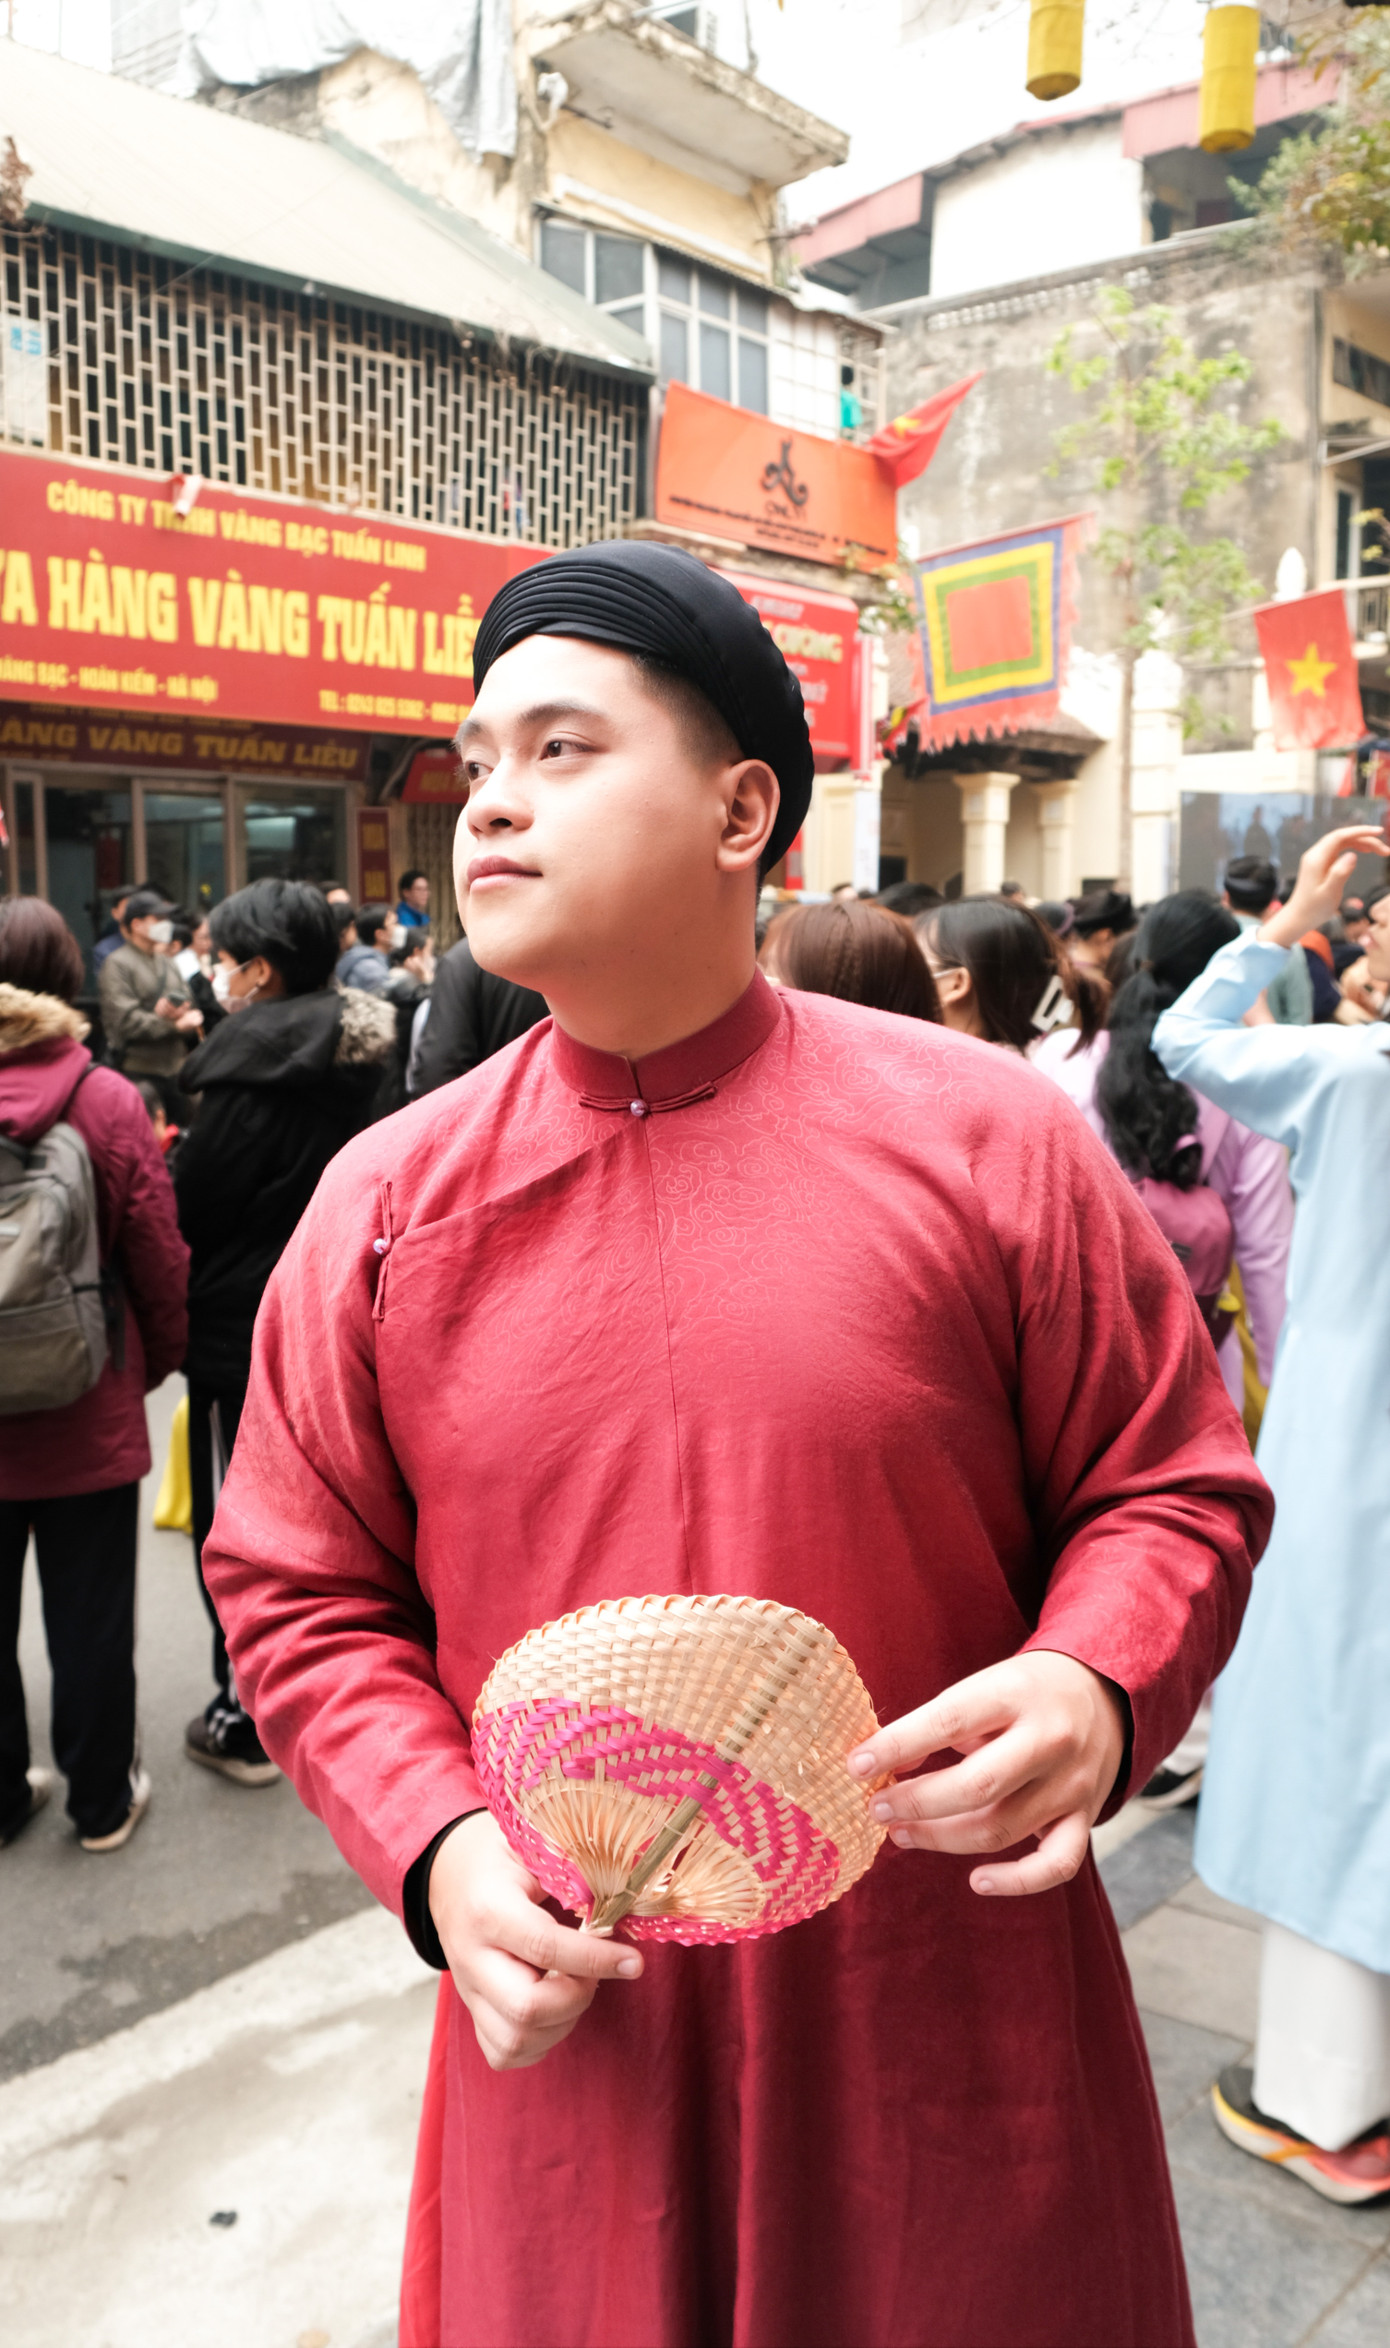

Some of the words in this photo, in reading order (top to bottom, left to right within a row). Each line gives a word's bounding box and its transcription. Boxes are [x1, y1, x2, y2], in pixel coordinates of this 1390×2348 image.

[47, 479, 114, 522] CÔNG
[118, 493, 147, 527] TY
[219, 508, 282, 548] VÀNG
[285, 521, 329, 558] BẠC
[331, 527, 381, 565] TUẤN
[383, 539, 426, 573] LINH
[47, 547, 178, 643] HÀNG
[188, 567, 310, 659] VÀNG
[317, 580, 418, 672] TUẤN
[422, 593, 483, 680] LIỀ
[0, 716, 77, 748] ÀNG
[88, 726, 184, 756] VÀNG
[194, 732, 287, 763] TUẤN
